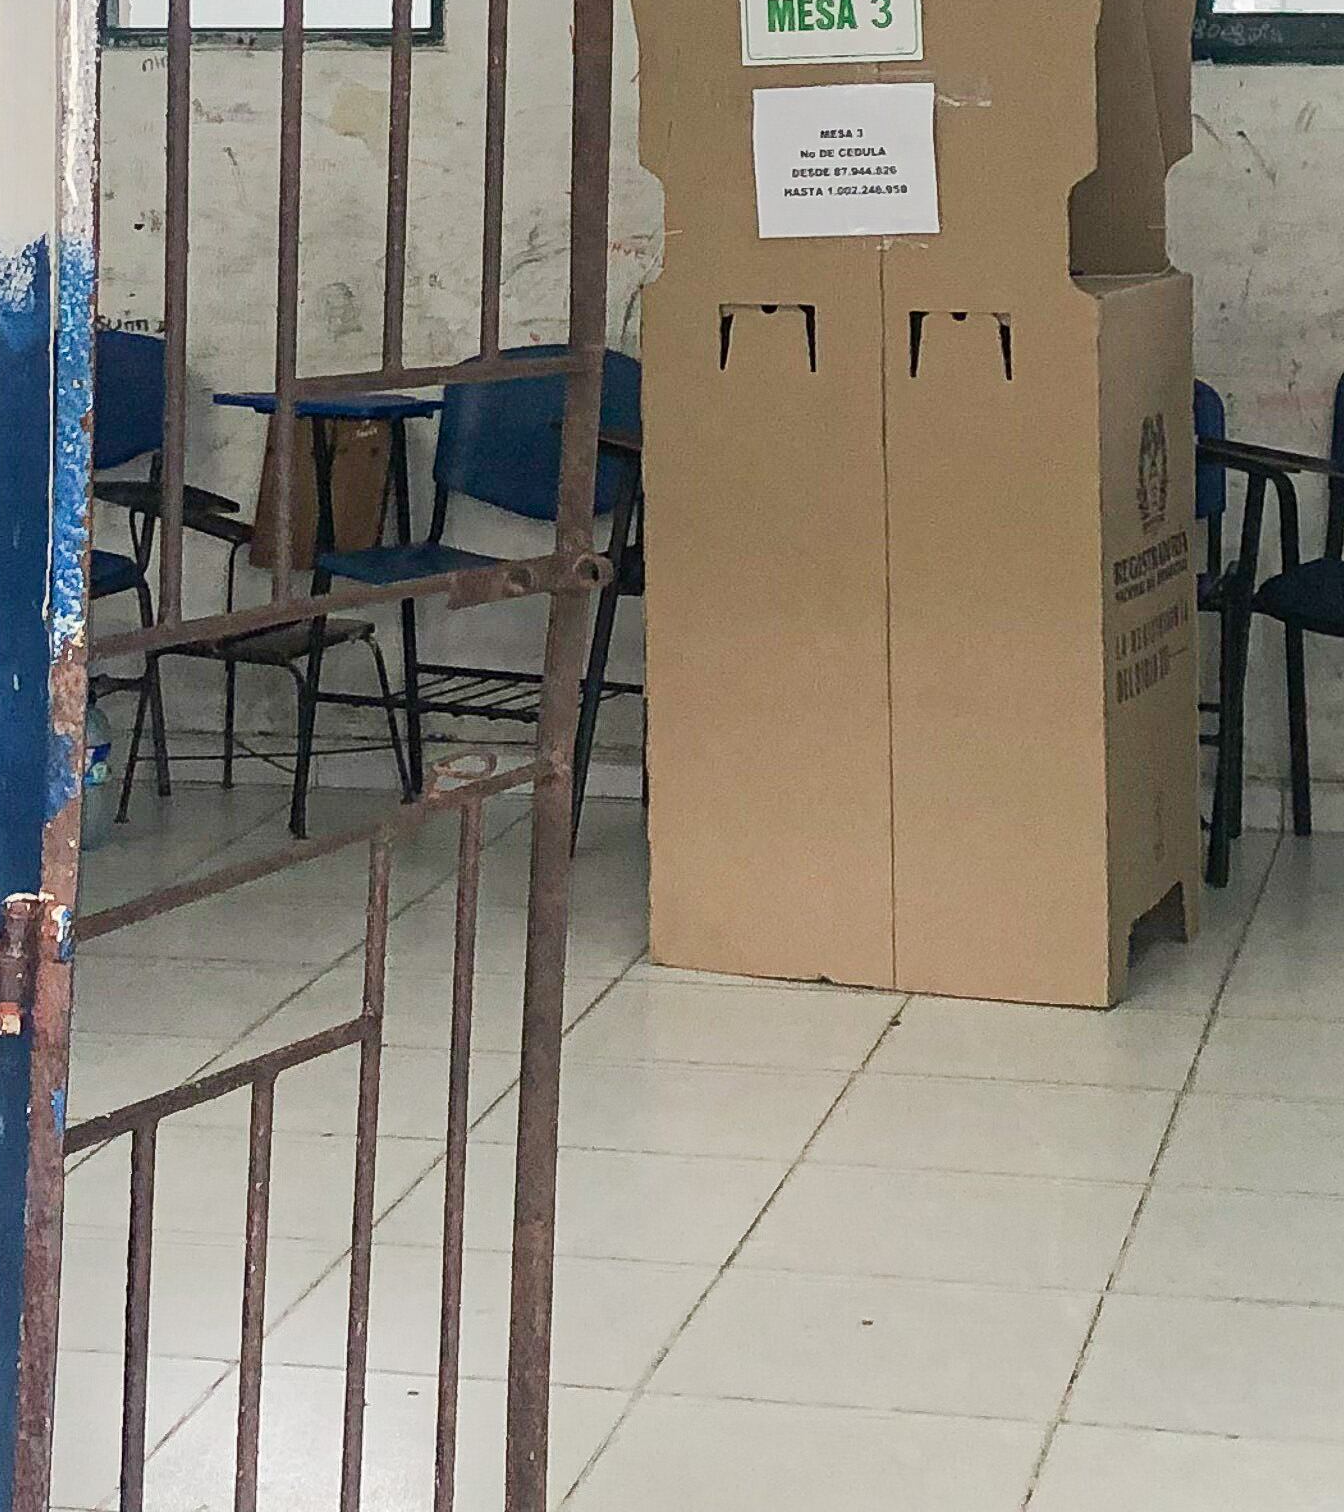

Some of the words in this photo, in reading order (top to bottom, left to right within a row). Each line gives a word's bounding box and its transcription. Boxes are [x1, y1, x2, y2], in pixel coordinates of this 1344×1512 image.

[820, 129, 852, 138] MESA
[819, 149, 834, 157] DE
[838, 147, 886, 157] CEDULA
[792, 168, 829, 178] DESDE
[784, 187, 823, 196] HASTA
